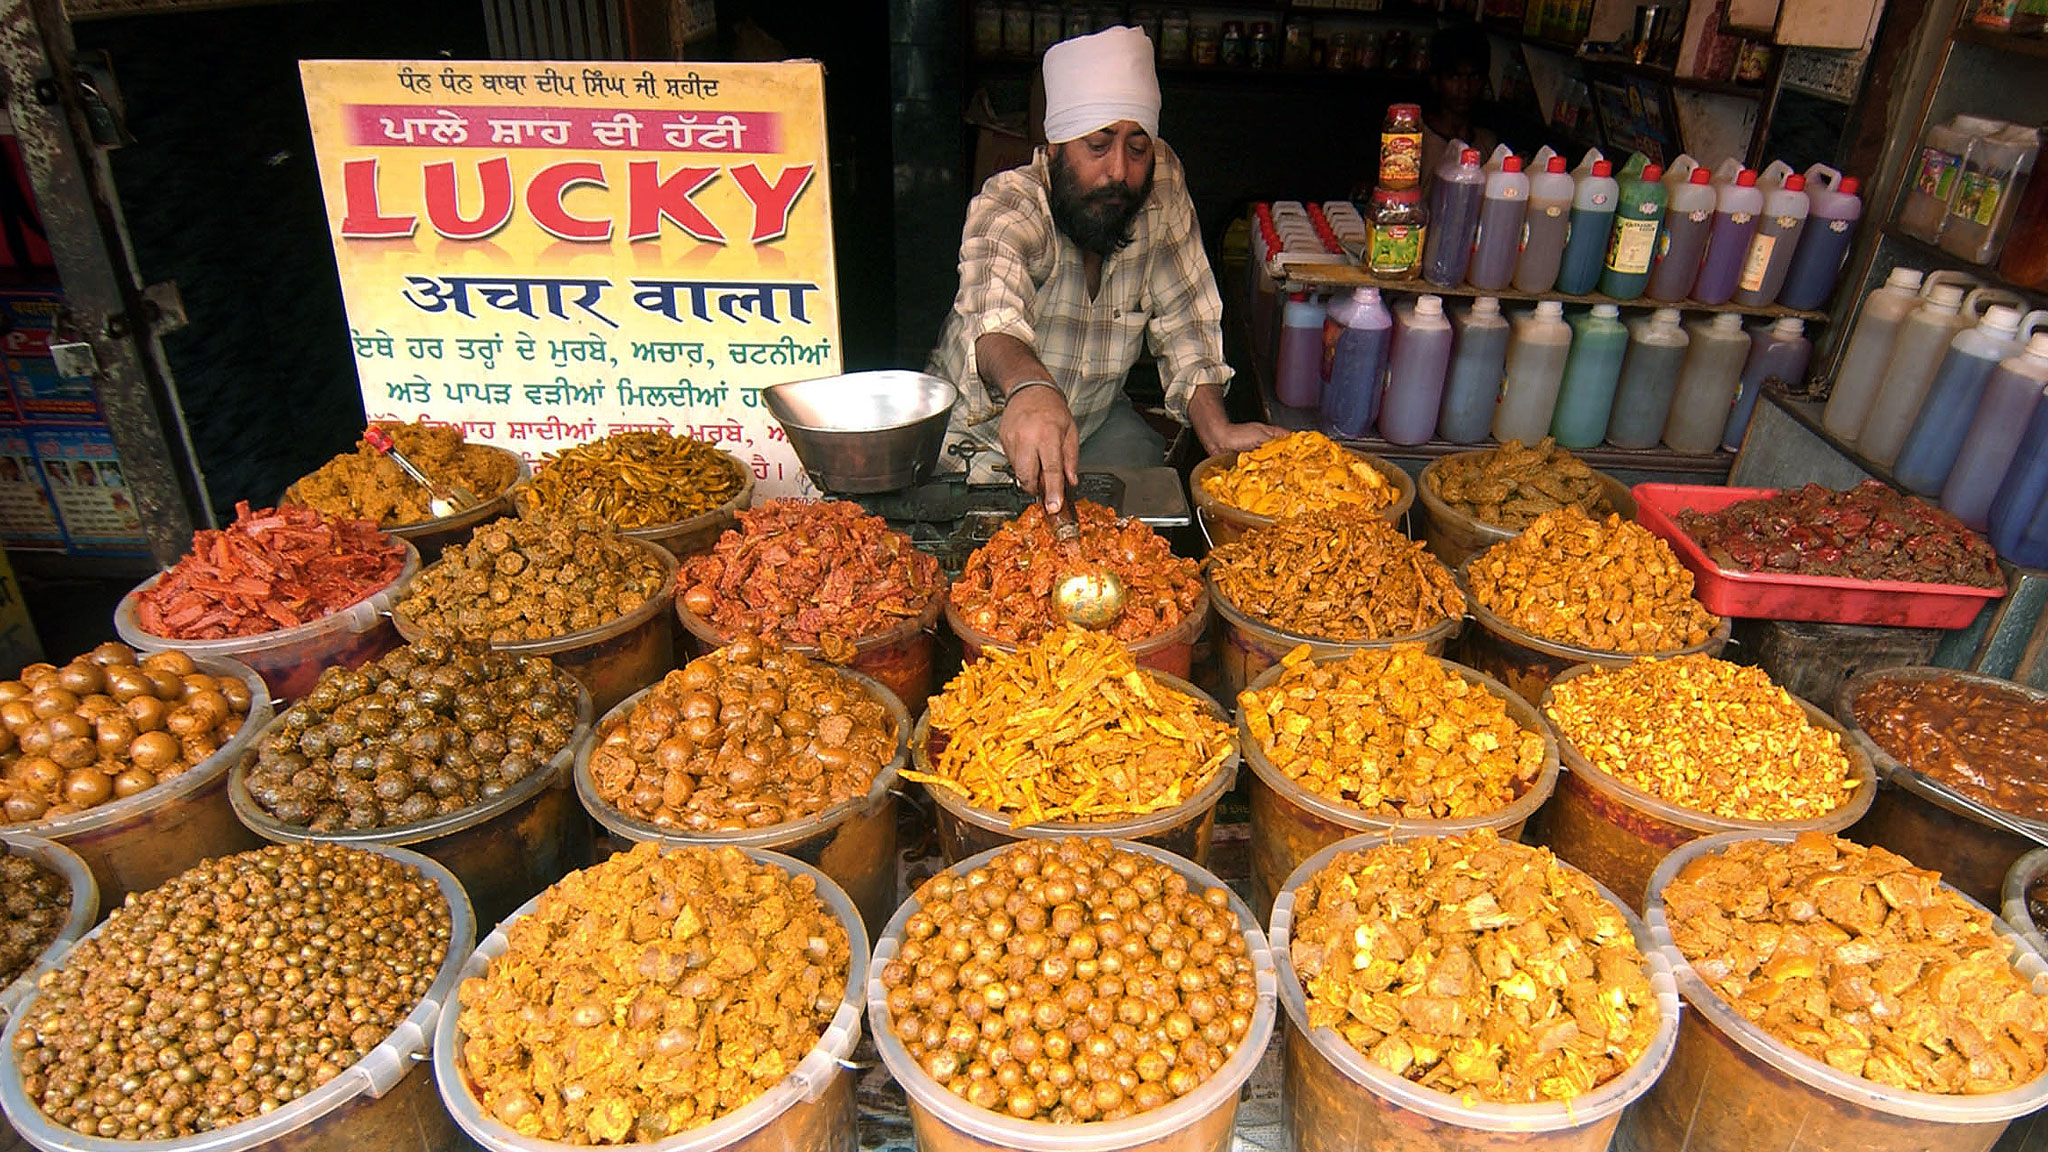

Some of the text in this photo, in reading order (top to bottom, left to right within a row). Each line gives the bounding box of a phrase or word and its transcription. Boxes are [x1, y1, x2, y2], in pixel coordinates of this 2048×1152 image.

[397, 66, 719, 100] ਧੰਨ ਧੰਨ ਬਾਬਾ ਦੀਪ ਸਿੰਘ ਜੀ ਸ਼ਹੀਦ
[379, 109, 747, 149] ਪਾਲੇ ਸ਼ਾਹ ਦੀ ਹੱਟੀ
[341, 157, 814, 246] LUCKY
[403, 276, 819, 328] अचार वाला
[406, 338, 444, 359] ਹਰ
[456, 333, 503, 369] ਤਰ੍ਹਾਂ
[515, 331, 536, 360] ਦੇ
[548, 332, 618, 368] ਮੁਰਬੇ,
[632, 342, 714, 369] ਅਚਾਰ,
[729, 336, 831, 365] ਚਟਨੀਆਂ
[387, 374, 767, 408] ਅਤੇ ਪਾਪੜ ਵੜੀਆਂ ਮਿਲਦੀਆਂ ਹ
[507, 415, 596, 440] ਸ਼ਾਦੀਆਂ
